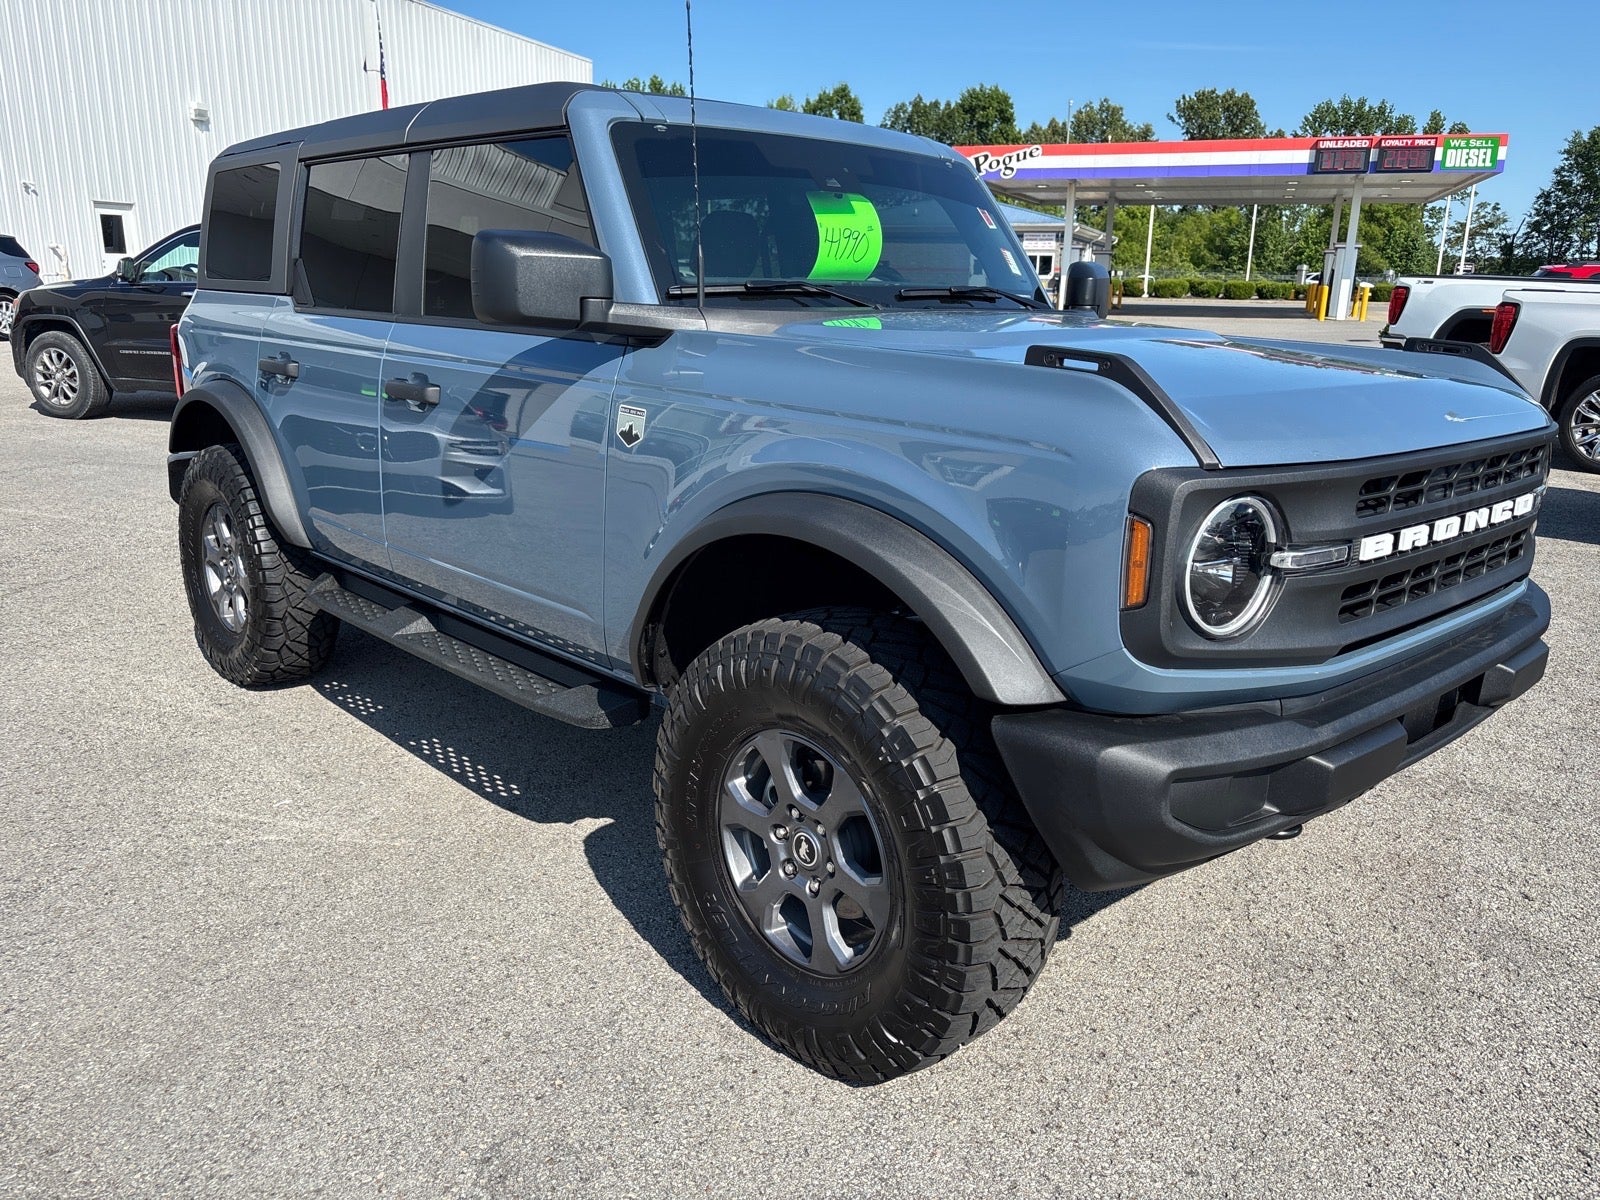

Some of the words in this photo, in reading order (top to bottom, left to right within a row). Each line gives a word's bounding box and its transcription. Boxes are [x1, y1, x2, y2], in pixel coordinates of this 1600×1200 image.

[1319, 140, 1370, 149] UNLEADED
[1381, 139, 1412, 147] LOYALTY
[973, 146, 1041, 177] Pogue
[1445, 148, 1493, 168] DIESEL
[1358, 493, 1535, 561] BRONCO
